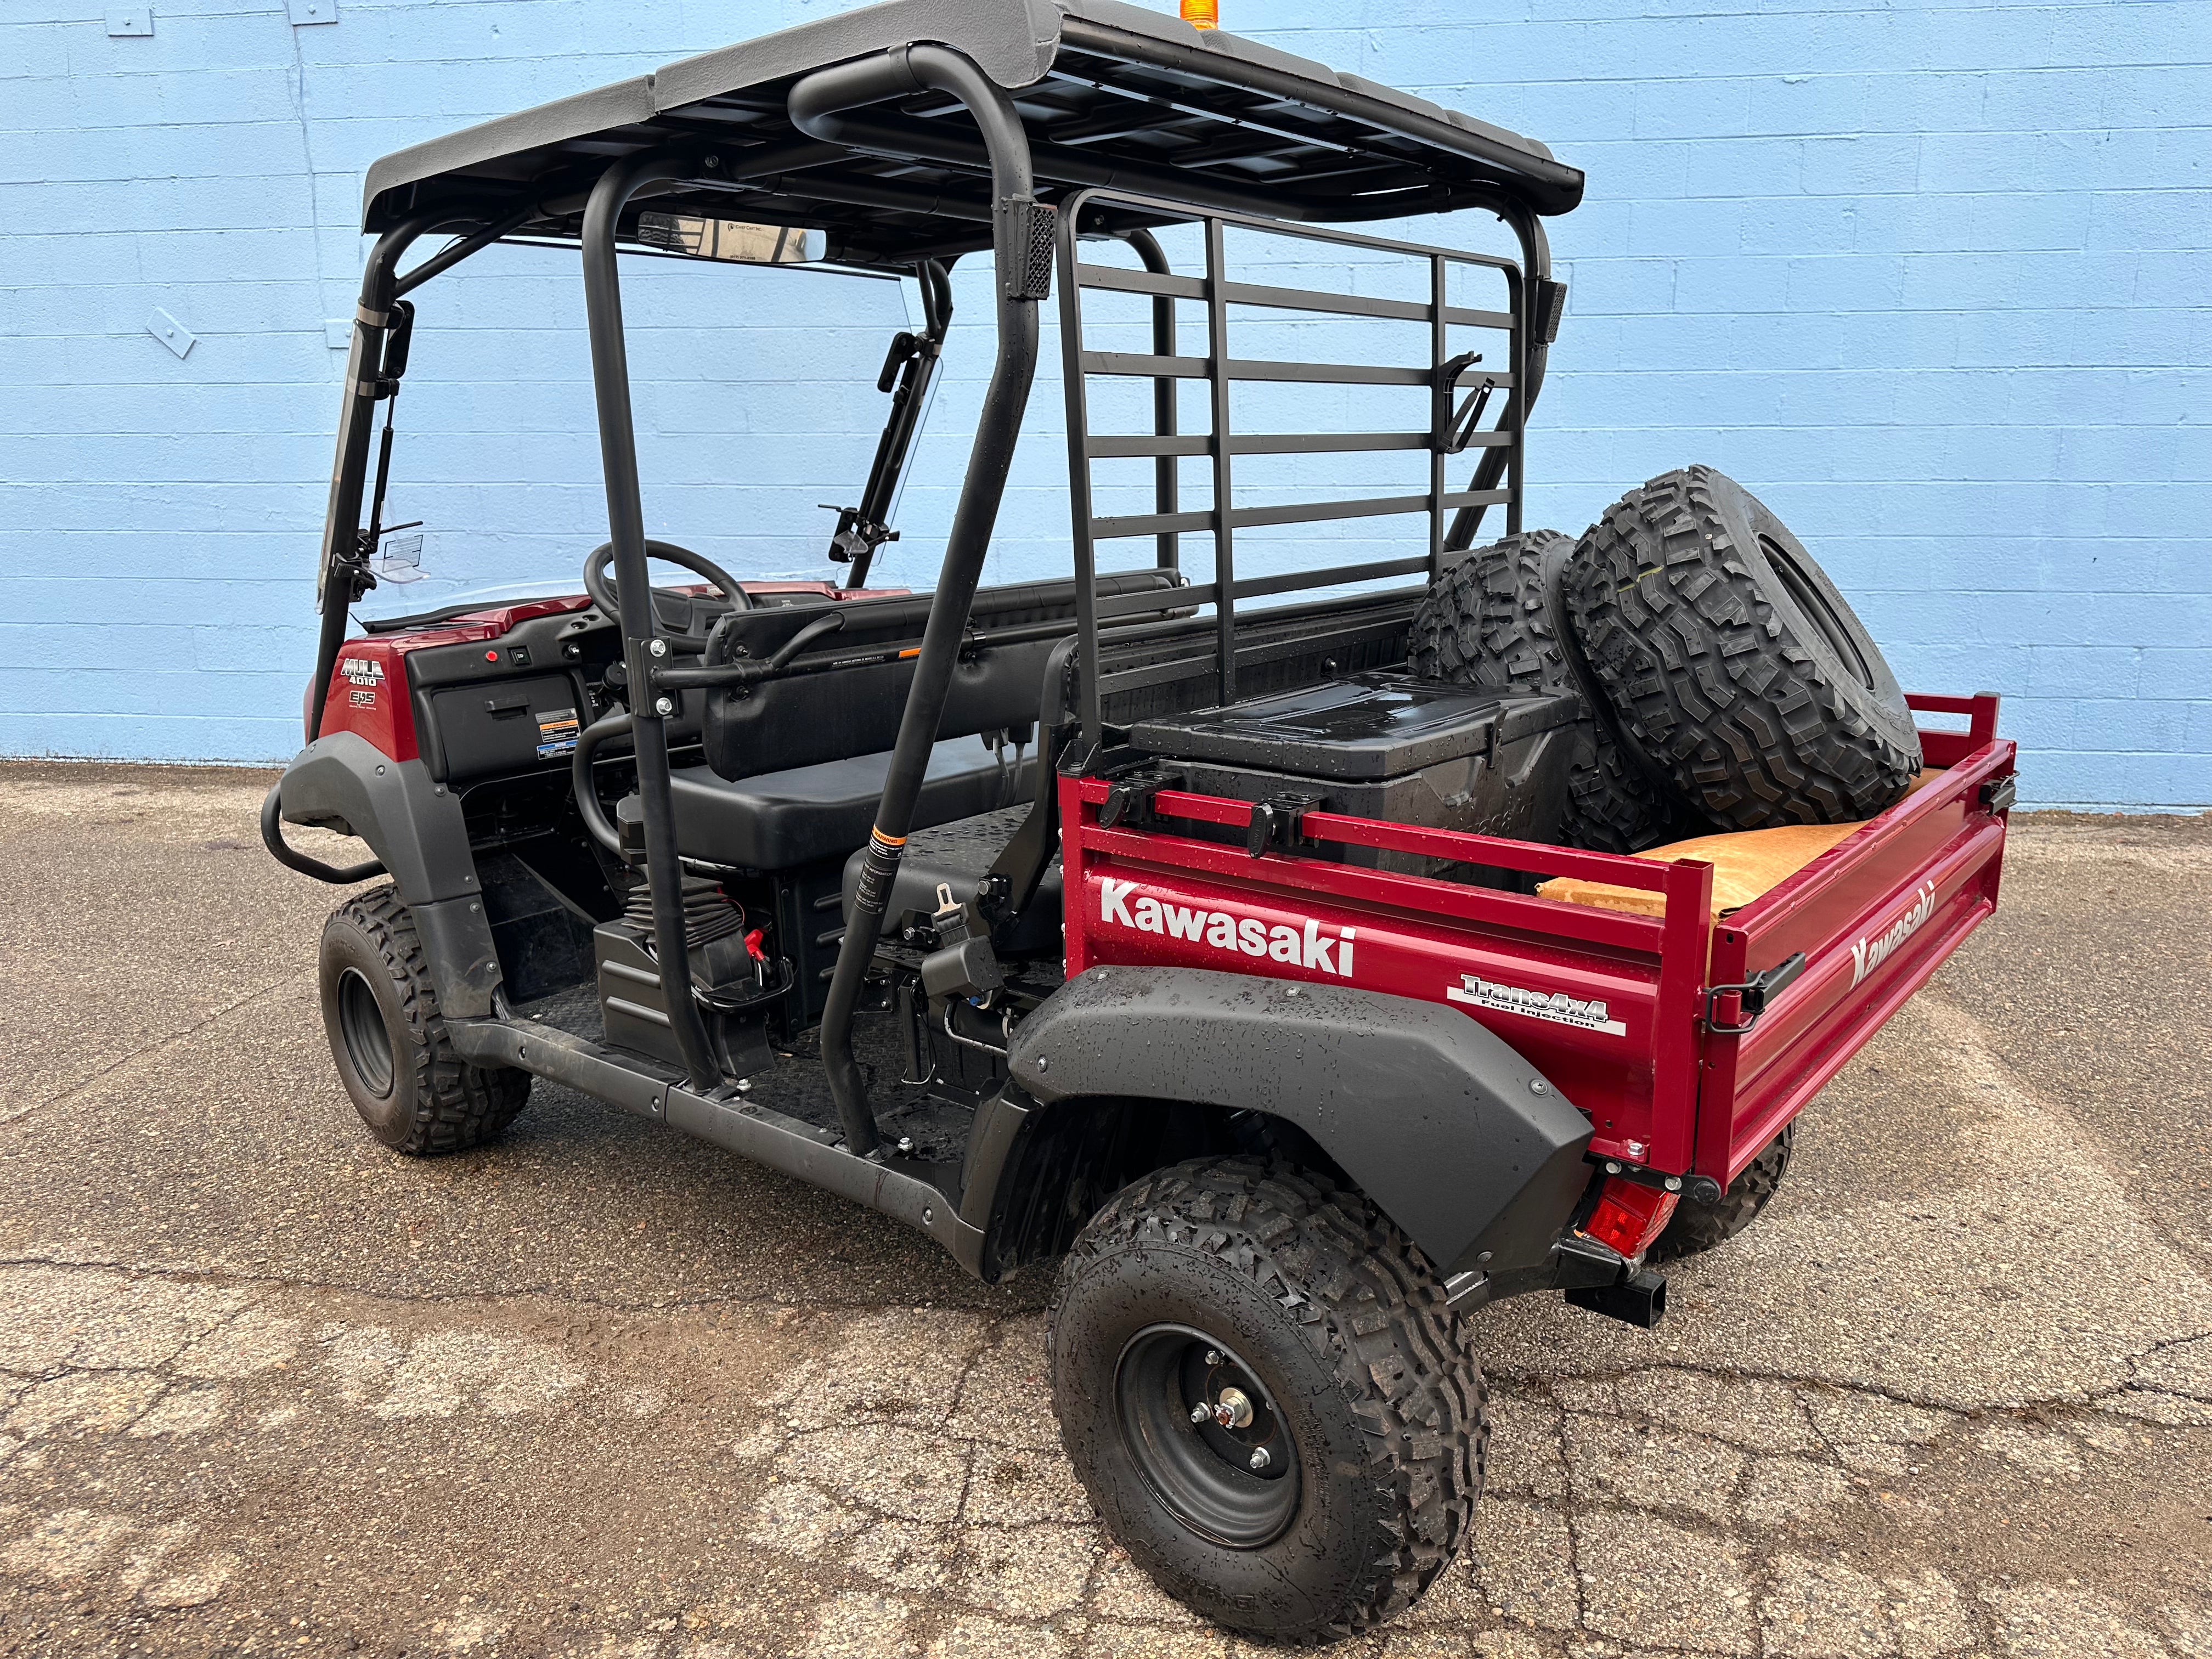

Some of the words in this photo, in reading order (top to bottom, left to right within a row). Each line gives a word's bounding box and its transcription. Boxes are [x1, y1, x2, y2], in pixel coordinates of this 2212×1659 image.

[341, 658, 385, 680] MULE
[349, 676, 376, 686] 4010
[874, 831, 898, 844] WARNING
[1101, 877, 1356, 978] Kawasaki
[1849, 879, 1935, 991] Kawasaki
[1460, 974, 1609, 1023] Trans4x4
[1481, 1000, 1515, 1011] Fuel
[1521, 1008, 1595, 1028] Injection
